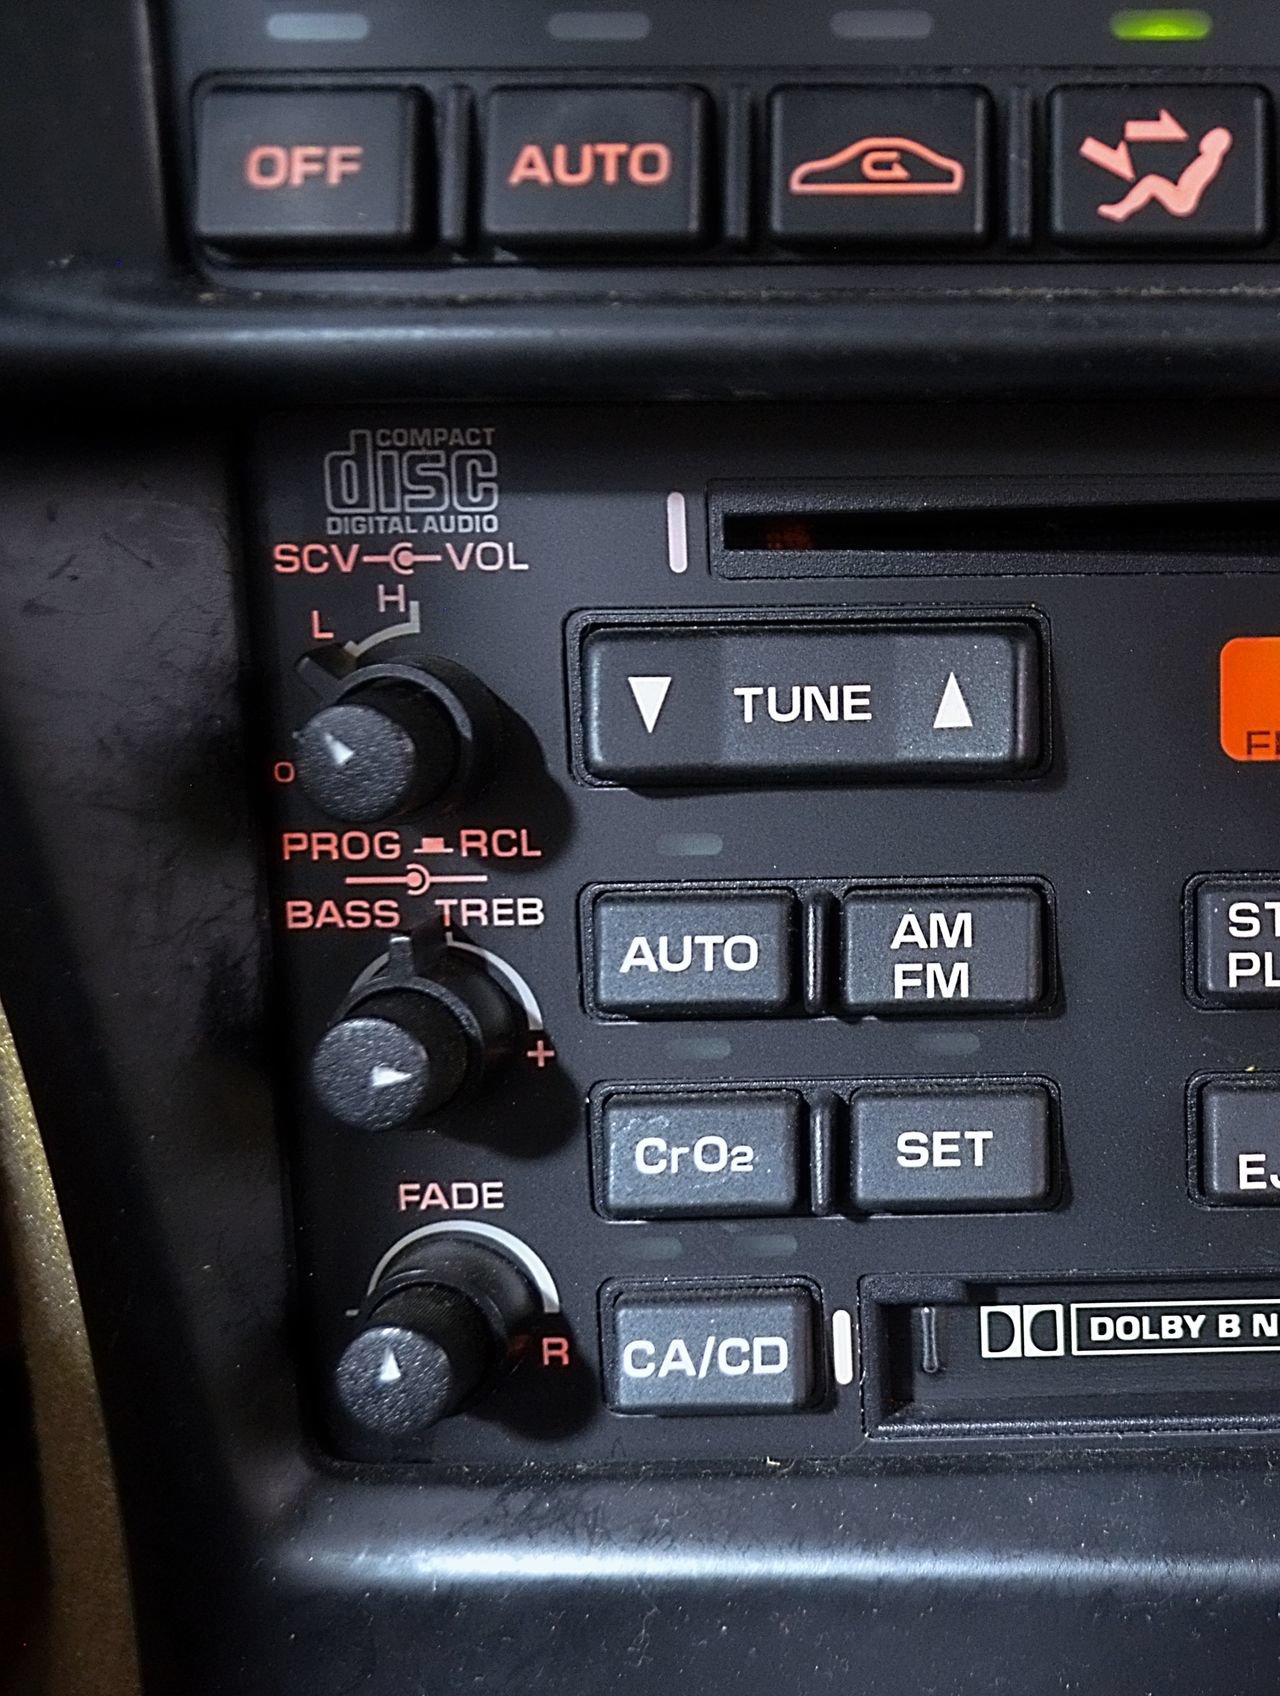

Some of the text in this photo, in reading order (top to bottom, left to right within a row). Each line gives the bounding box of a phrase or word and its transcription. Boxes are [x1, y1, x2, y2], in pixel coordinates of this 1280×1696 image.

[245, 144, 364, 189] OFF
[508, 141, 672, 187] AUTO
[376, 428, 496, 447] COMPACT
[324, 429, 499, 514] disc
[326, 514, 499, 535] DIGITAL AUDIO
[272, 541, 530, 574] SCV VOL
[377, 583, 405, 613] H
[311, 609, 335, 639] L
[733, 684, 873, 724] TUNE
[281, 828, 543, 861] PROG RCL
[285, 897, 545, 929] BASS TREB
[889, 912, 973, 950] AM
[619, 934, 759, 973] AUTO
[893, 961, 970, 999] FM
[634, 1135, 755, 1175] CrO2
[896, 1130, 994, 1168] SET
[399, 1181, 505, 1212] FADE
[1090, 1314, 1207, 1342] DOLBY
[1217, 1314, 1241, 1339] B
[541, 1336, 570, 1366] R
[622, 1335, 790, 1379] CA/CD
